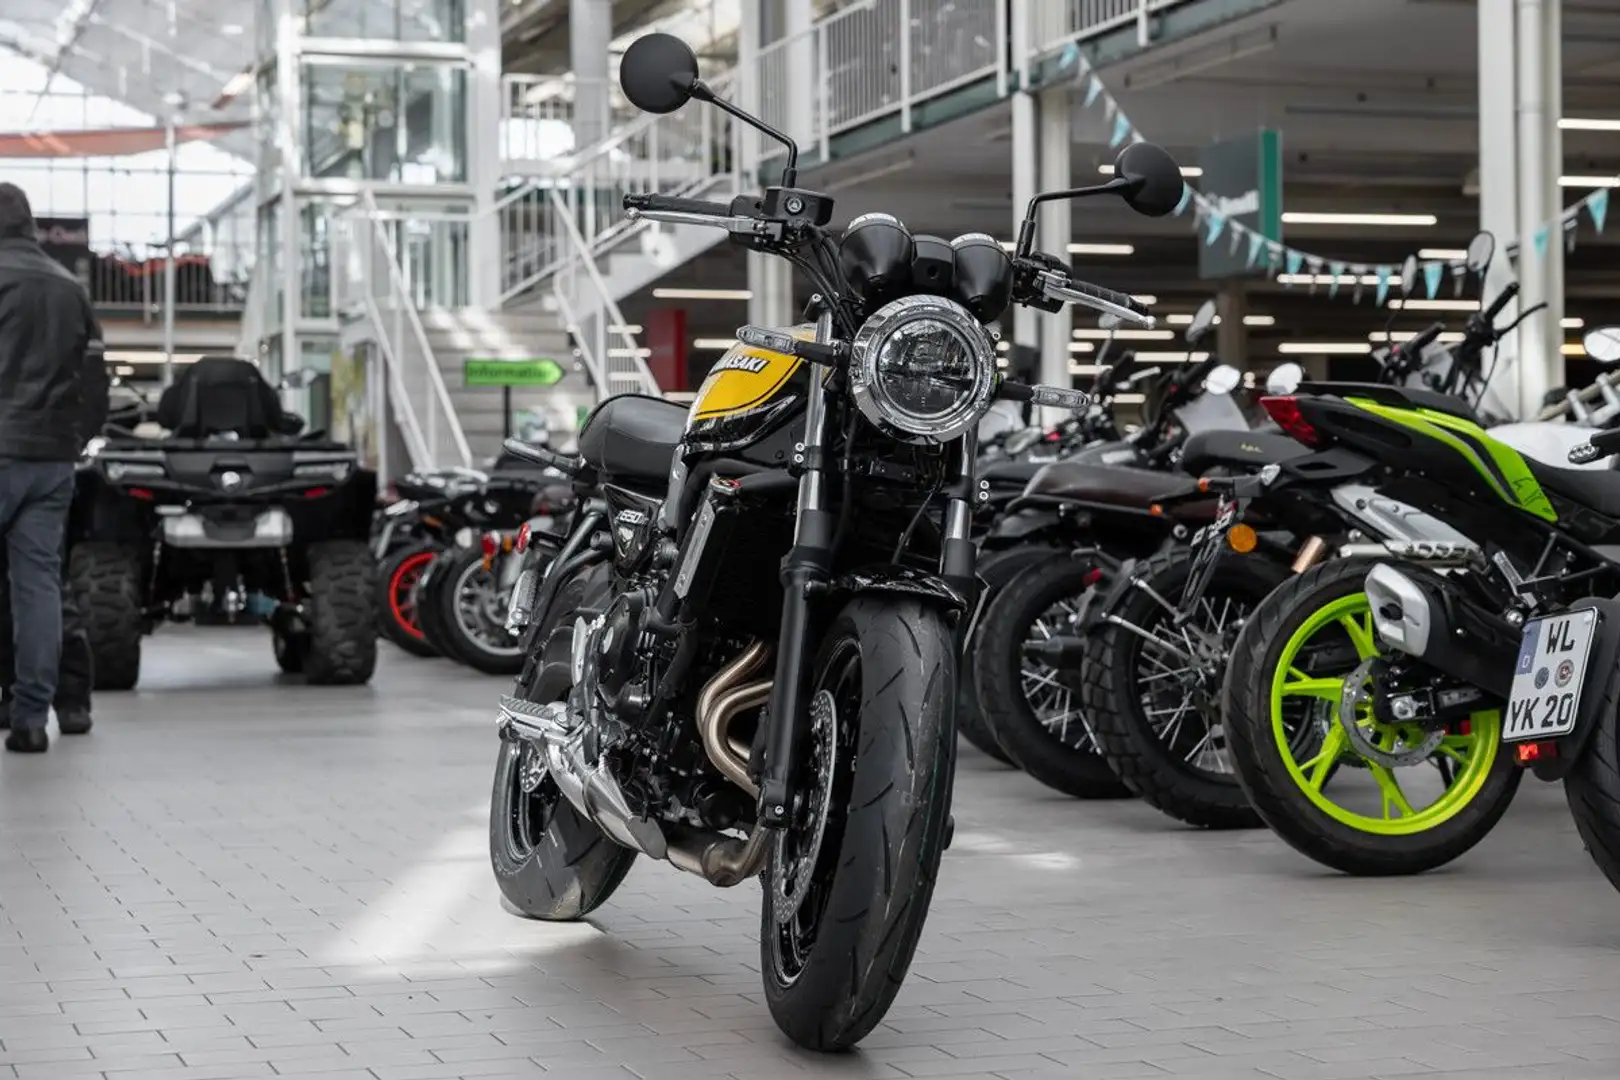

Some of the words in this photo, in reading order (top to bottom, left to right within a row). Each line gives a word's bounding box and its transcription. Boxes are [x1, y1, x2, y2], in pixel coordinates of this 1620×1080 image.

[1546, 620, 1576, 654] WL
[1521, 655, 1531, 669] D
[1510, 697, 1540, 732] YK
[1541, 692, 1574, 728] 20
